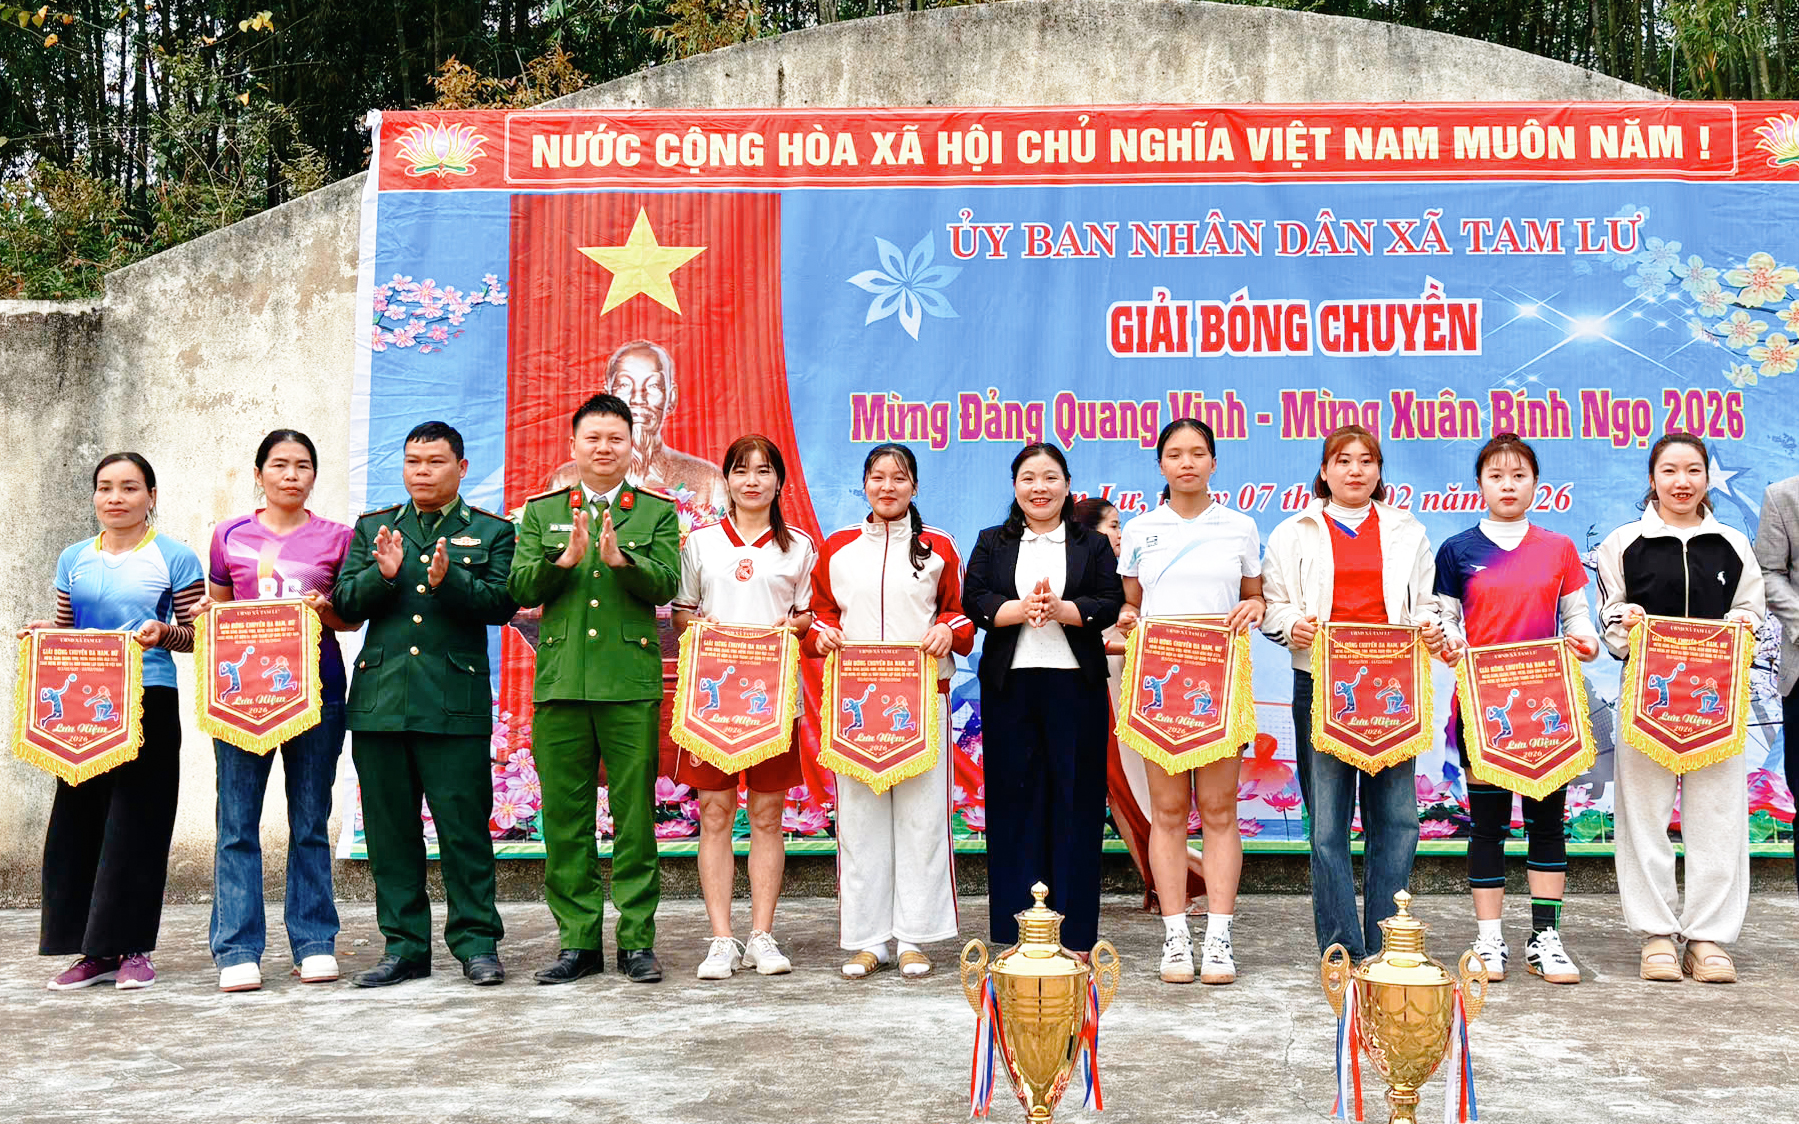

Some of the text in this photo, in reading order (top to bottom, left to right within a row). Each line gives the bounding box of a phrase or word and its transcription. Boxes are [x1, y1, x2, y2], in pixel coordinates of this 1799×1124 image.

[532, 114, 1710, 175] NƯỚC CỘNG HÒA XÃ HỘI CHỦ NGHĨA VIỆT NAM MUÔN NĂM !
[948, 210, 1642, 258] ỦY BAN NHÂN DÂN XÃ TAM LƯ
[1110, 282, 1478, 353] GIẢI BÓNG CHUYỀN
[851, 392, 949, 449] Mừng
[959, 388, 1044, 447] Đảng
[1054, 391, 1159, 450] Quang
[1167, 390, 1246, 438] Vinh
[1281, 389, 1381, 440] Mừng
[1391, 389, 1481, 439] Xuân
[1490, 389, 1571, 439] Bính
[1581, 389, 1652, 447] Ngọ
[1664, 389, 1745, 439] 2026
[1238, 485, 1275, 511] 07
[1421, 484, 1488, 511] năm
